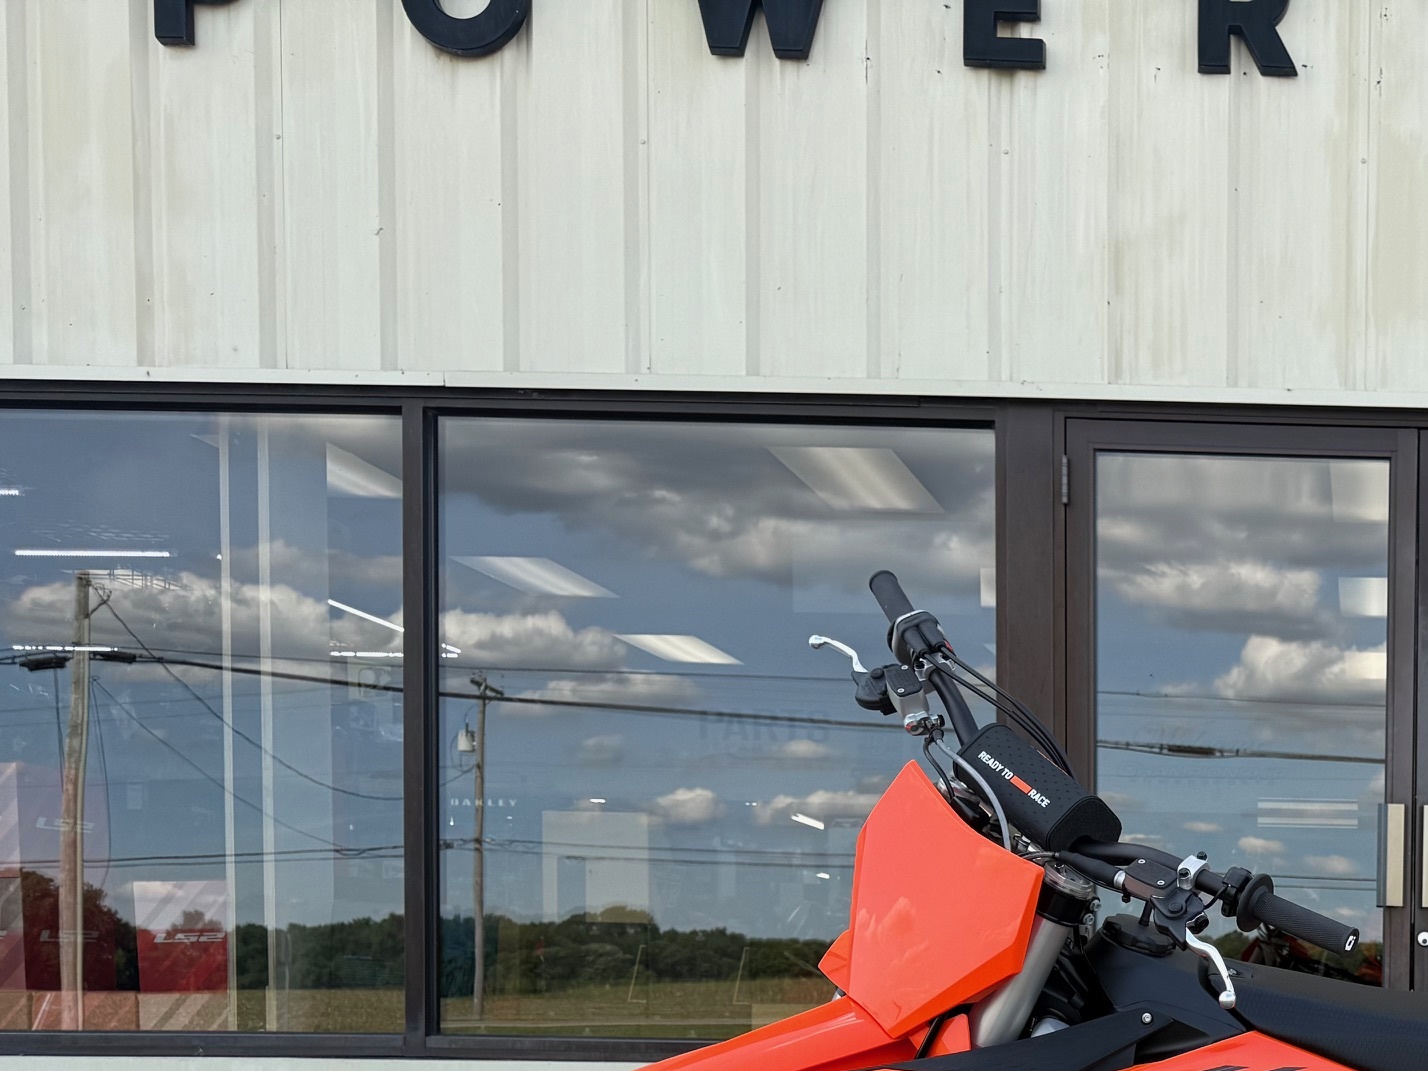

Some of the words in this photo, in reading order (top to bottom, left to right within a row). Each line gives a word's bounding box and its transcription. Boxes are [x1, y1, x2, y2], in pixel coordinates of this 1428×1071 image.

[977, 751, 1004, 772] READY
[1001, 768, 1014, 780] TO
[1027, 789, 1051, 808] RACE
[450, 798, 518, 807] OAKLEY
[153, 932, 226, 944] LS2
